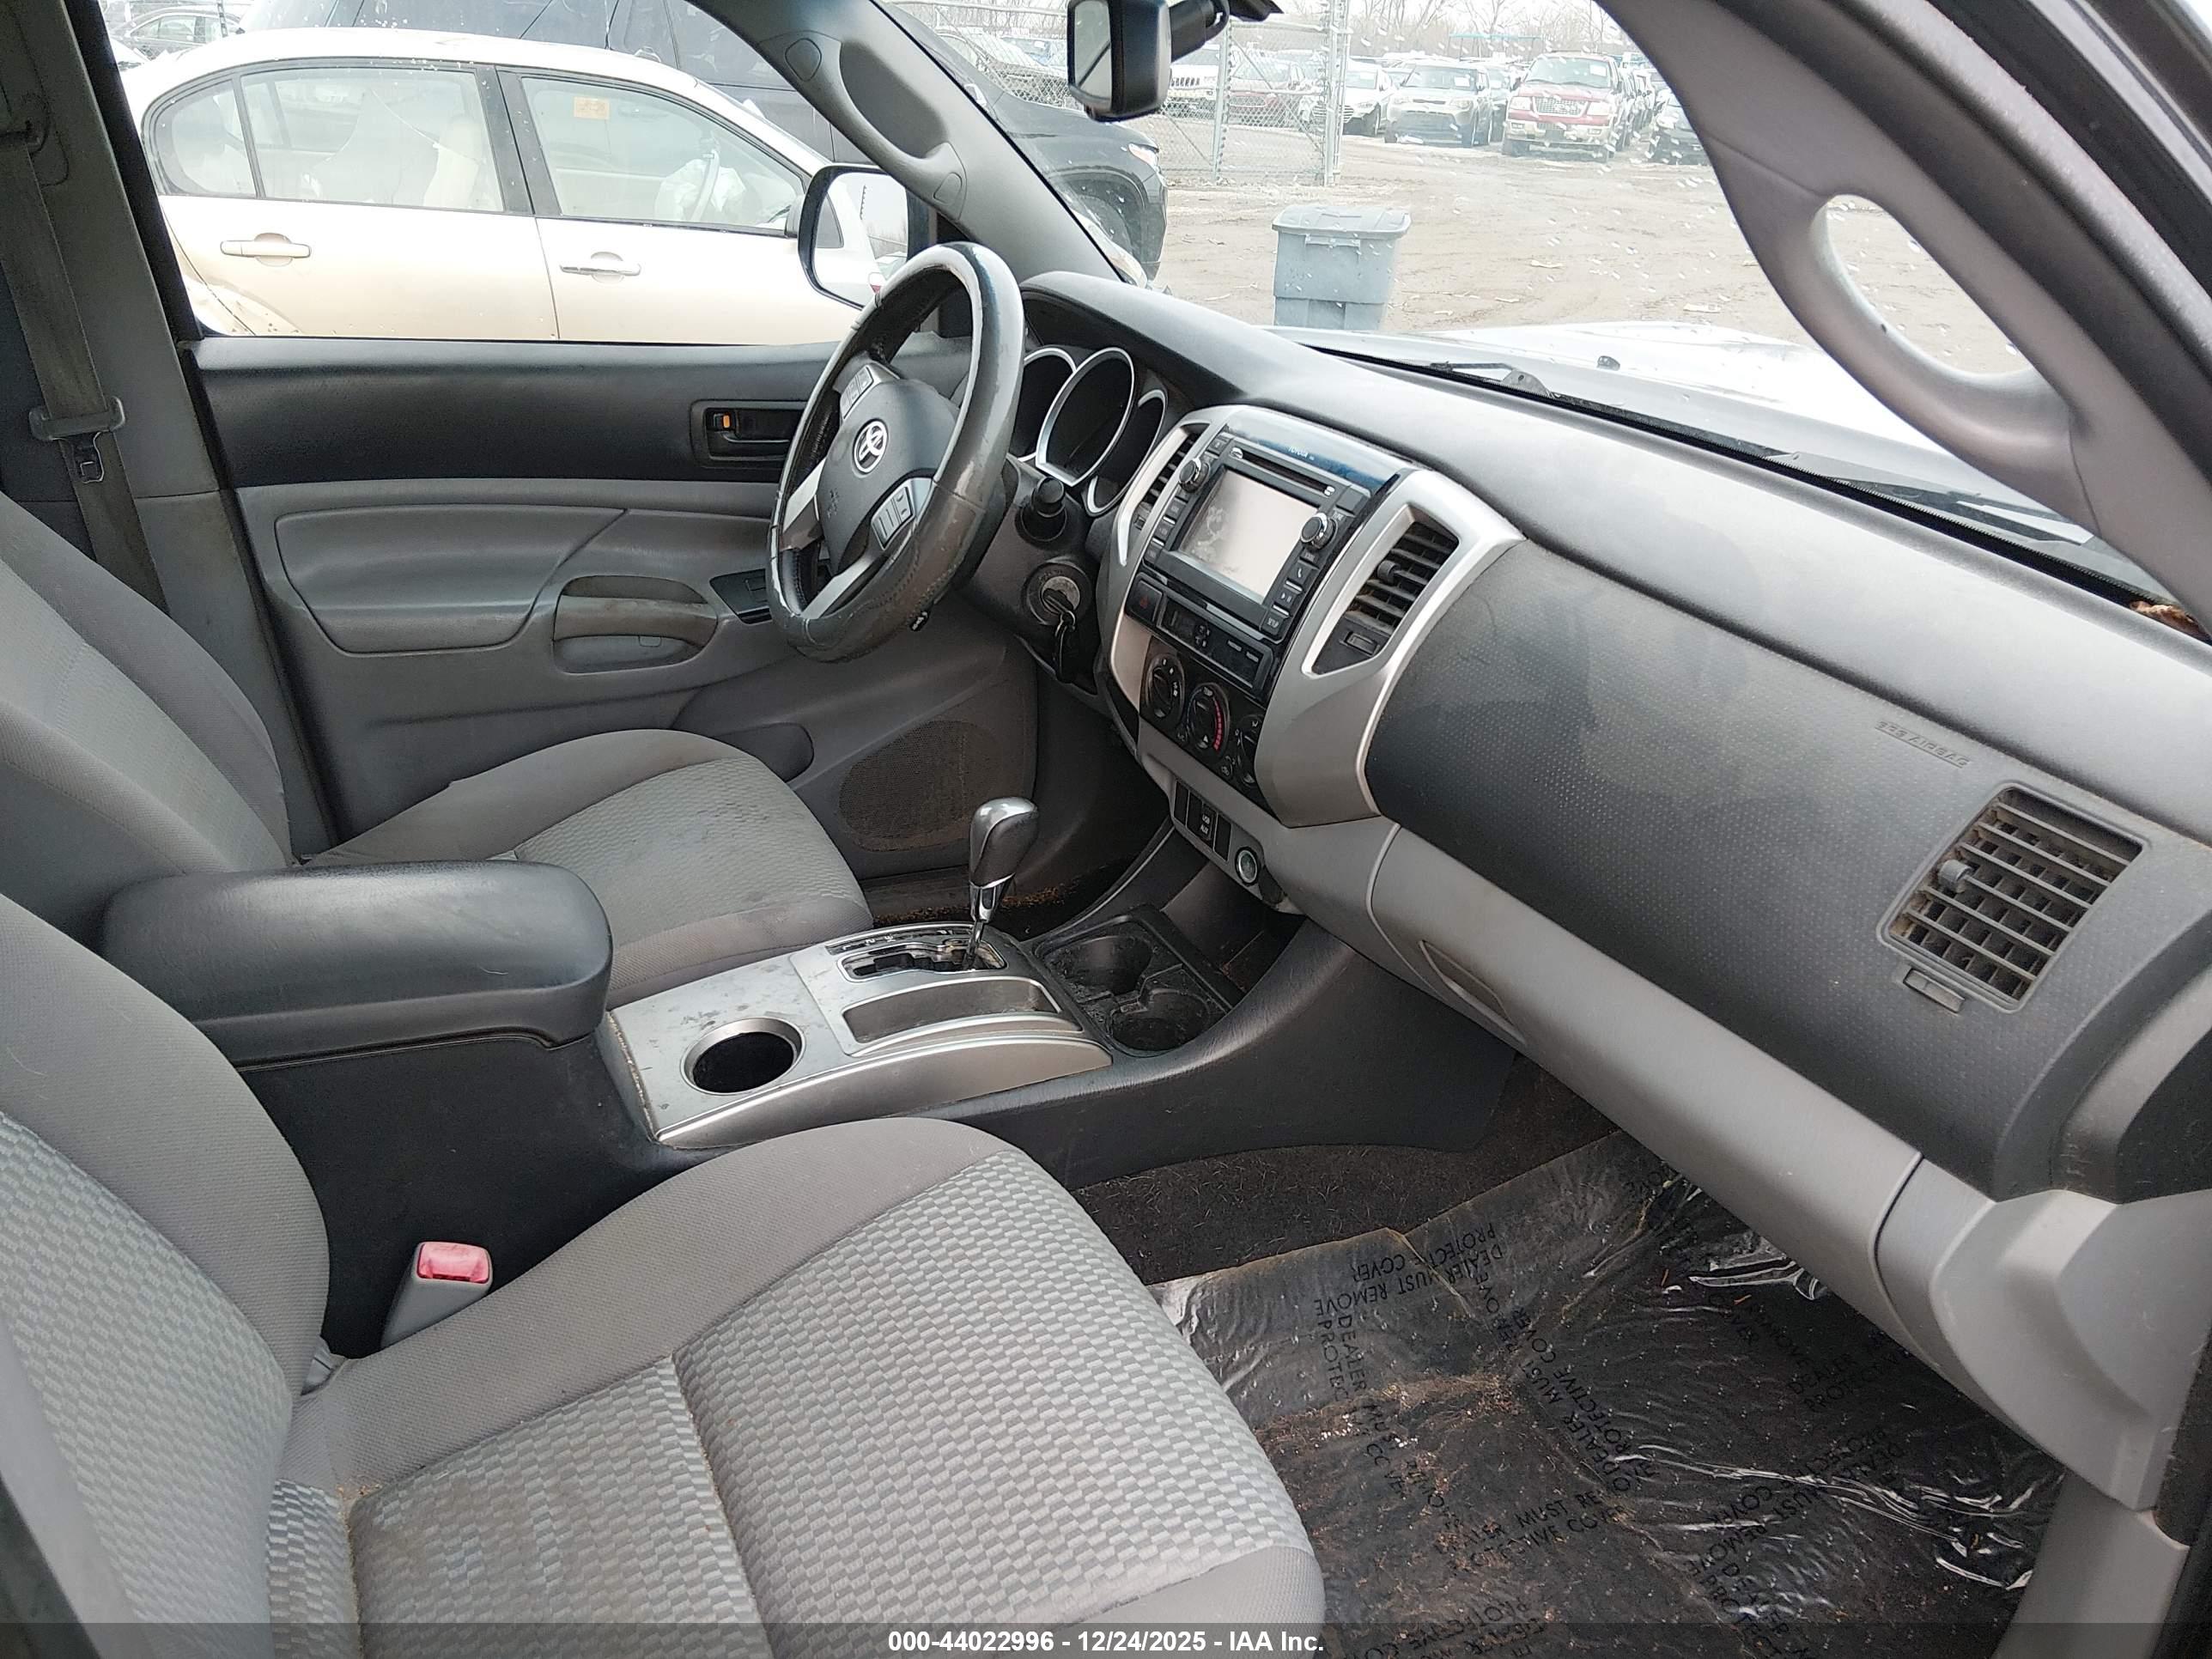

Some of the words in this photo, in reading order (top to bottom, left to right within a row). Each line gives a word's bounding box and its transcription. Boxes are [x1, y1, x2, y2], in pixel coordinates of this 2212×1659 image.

[1351, 1254, 1406, 1283] COVER
[1314, 1282, 1388, 1316] REMOVE
[1514, 1499, 1569, 1528] MUST
